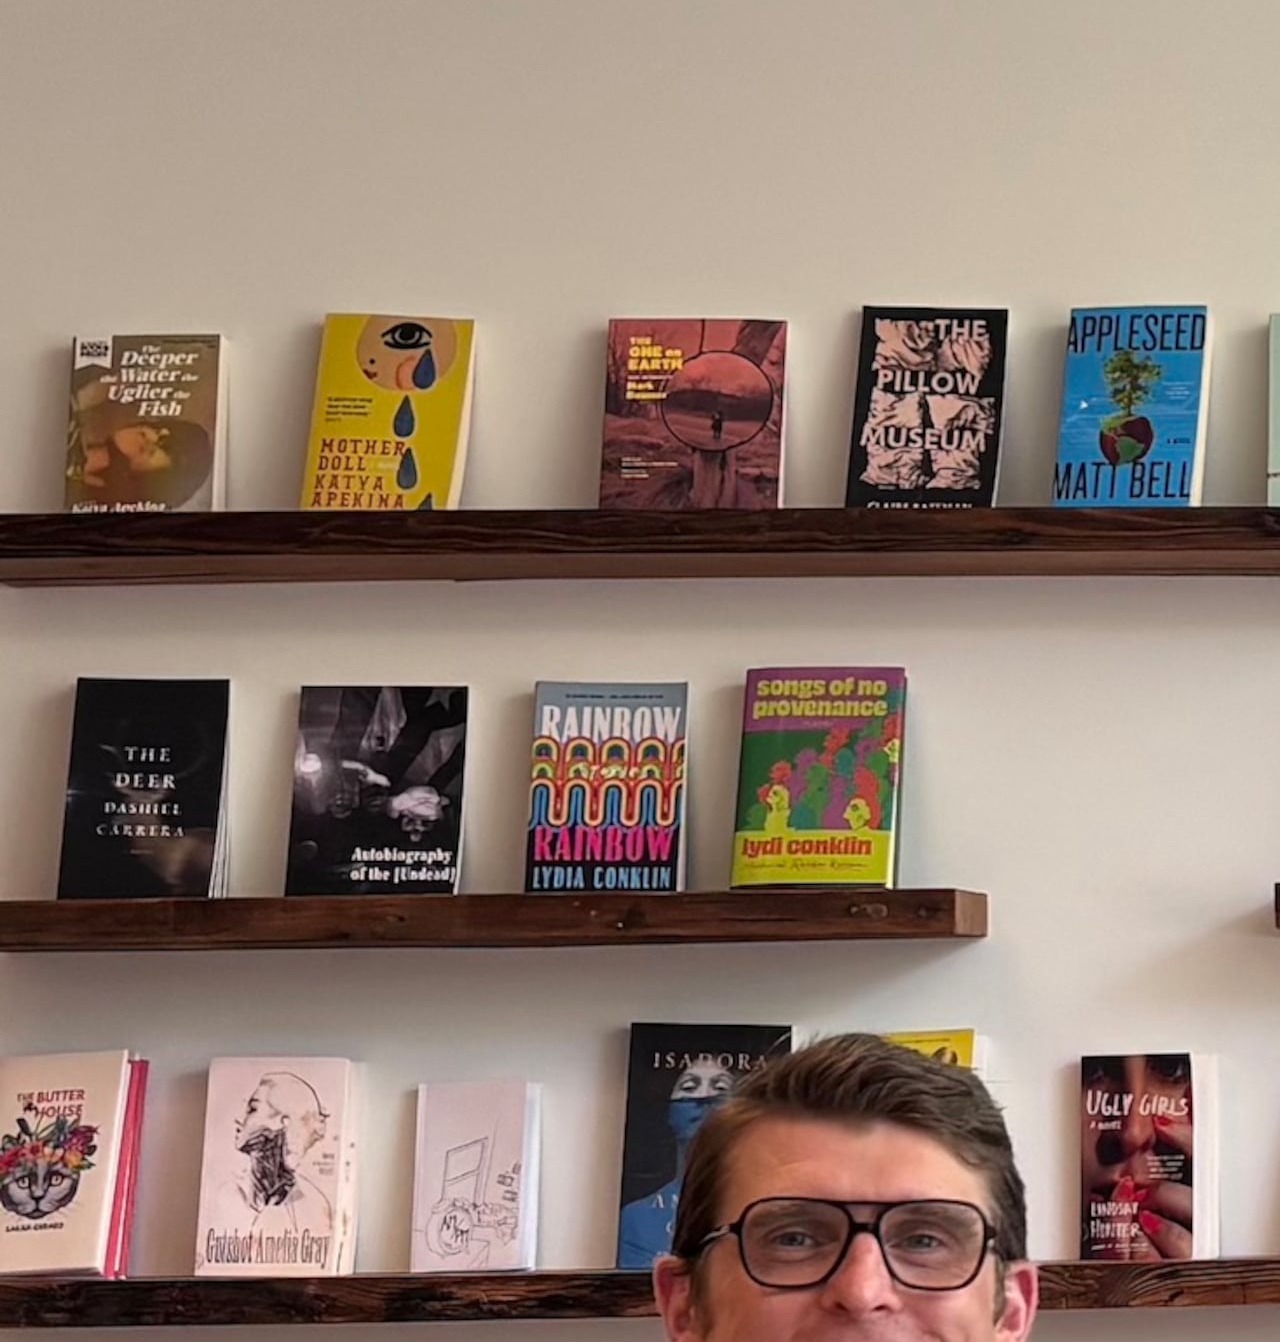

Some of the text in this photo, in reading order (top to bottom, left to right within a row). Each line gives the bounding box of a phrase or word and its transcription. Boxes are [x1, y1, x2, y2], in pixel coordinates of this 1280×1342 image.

[936, 320, 987, 340] THE
[1068, 313, 1206, 354] APPLESEED
[121, 350, 199, 369] Deeper
[629, 346, 663, 358] ONE
[627, 358, 683, 371] EARTH
[121, 369, 181, 383] Water
[877, 370, 981, 395] PILLOW
[108, 386, 173, 403] Uglier
[138, 401, 182, 416] Fish
[321, 439, 406, 456] MOTHER
[860, 427, 987, 452] MUSEUM
[318, 455, 367, 471] DOLL
[315, 474, 384, 490] KATYA
[1054, 462, 1191, 501] MATT BELL
[312, 492, 404, 507] APEKINA
[757, 677, 887, 699] songs of no
[752, 700, 887, 719] provenance
[541, 705, 681, 744] RAINBOW
[125, 746, 171, 762] THE
[114, 772, 176, 789] DEER
[96, 824, 184, 837] CARRERA
[534, 825, 673, 861] RAINBOW
[742, 837, 872, 858] lydi conklin
[351, 847, 453, 864] Autobiography
[350, 866, 456, 884] of the [Undead]
[533, 866, 671, 889] LYDIA CONKLIN
[653, 1051, 769, 1071] ISADORA
[17, 1089, 85, 1103] THE BUTTER
[1086, 1090, 1189, 1116] UGLY GIRLS
[37, 1104, 84, 1117] HOUSE
[1091, 1202, 1139, 1218] LINDSAY
[1091, 1220, 1143, 1239] HUNTER
[301, 1228, 331, 1269] Gray
